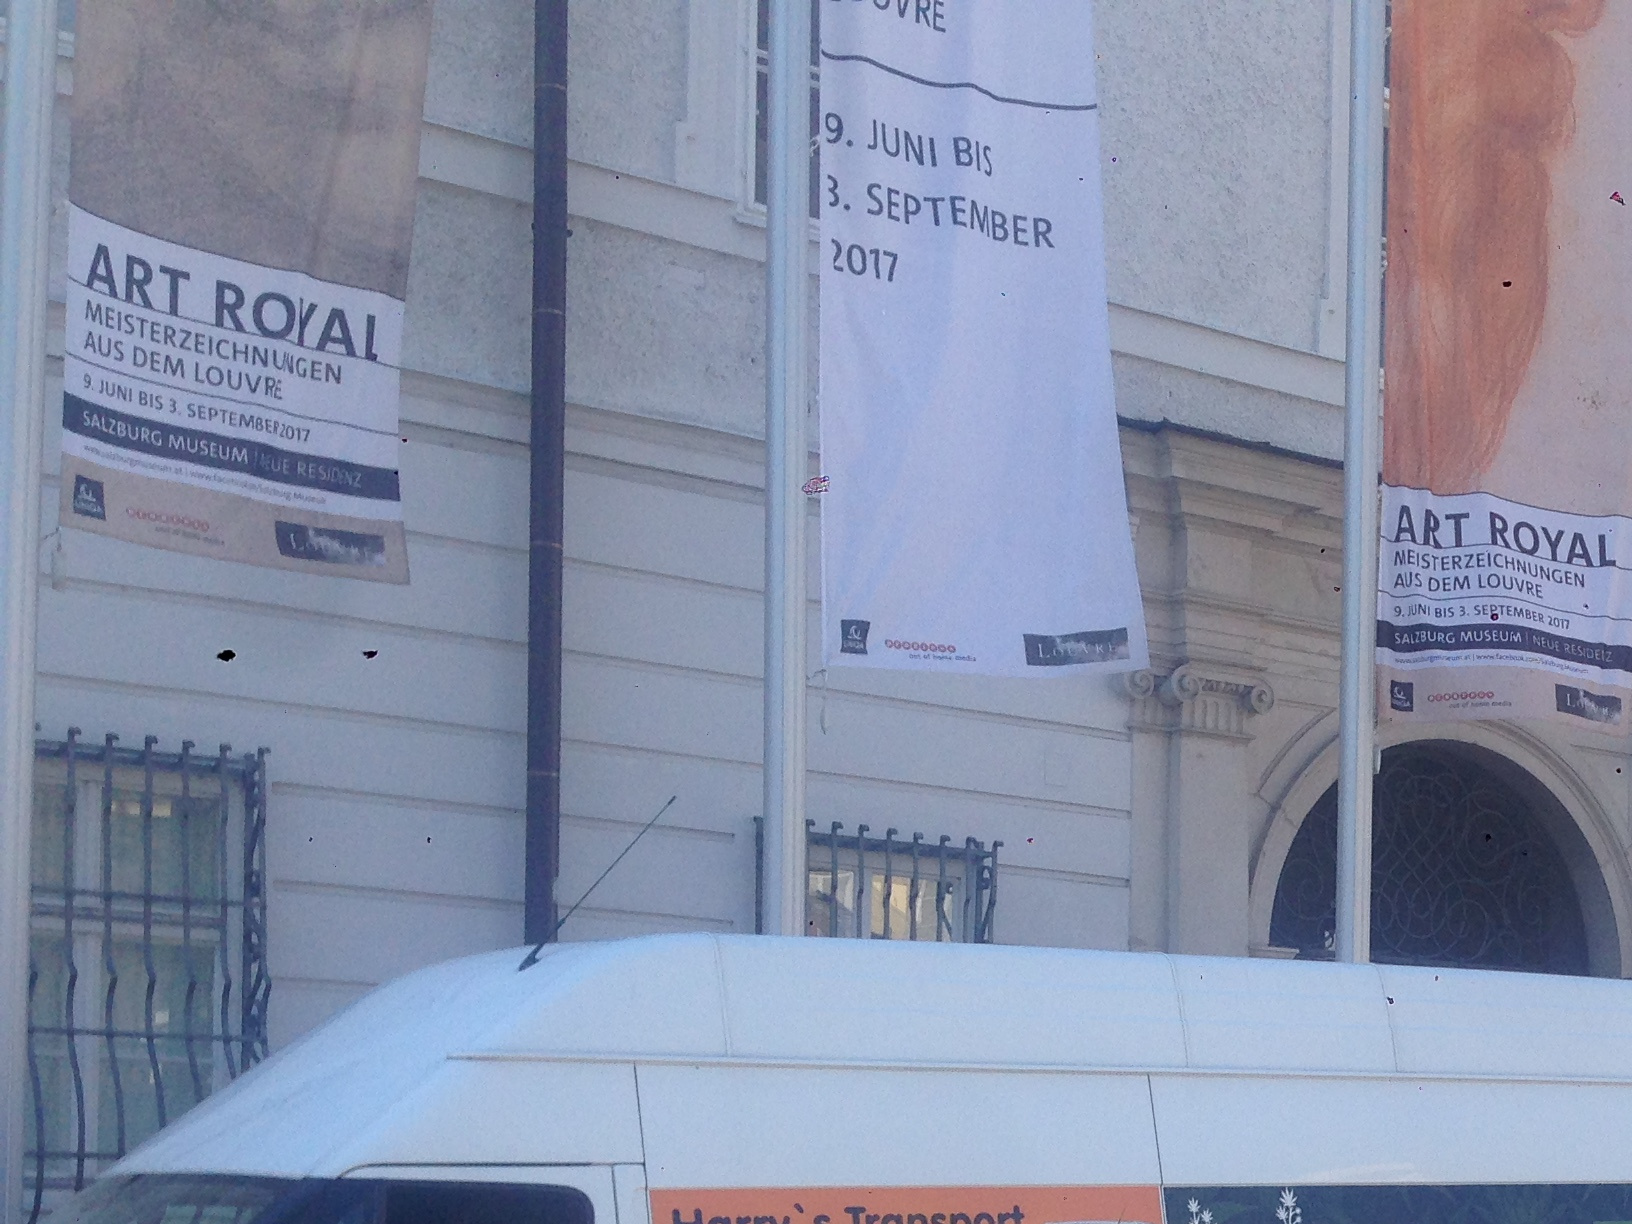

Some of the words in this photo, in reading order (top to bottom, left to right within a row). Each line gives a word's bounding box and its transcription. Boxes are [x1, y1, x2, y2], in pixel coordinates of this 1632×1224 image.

[825, 112, 853, 148] 9.
[867, 119, 937, 167] JUNI
[953, 136, 993, 177] BIS
[827, 175, 851, 211] 3.
[867, 183, 1055, 249] SEPTEMBER
[831, 238, 899, 282] 2017
[86, 243, 190, 316] ART
[215, 279, 378, 361] ROYAL
[84, 331, 124, 361] AUS
[133, 345, 185, 379] DEM
[194, 361, 283, 399] LOUVRE
[83, 373, 96, 392] 9.
[99, 379, 133, 402] JUNI
[139, 389, 163, 410] BIS
[170, 397, 182, 415] 3.
[83, 411, 162, 446] SALZBURG
[169, 435, 248, 464] MUSEUM
[1394, 505, 1470, 549] ART
[1489, 511, 1617, 568] ROYAL
[1394, 549, 1585, 588] MEISTERZEICHNUNGEN
[1394, 571, 1423, 590] AUS
[1428, 573, 1471, 592] DEM
[1478, 572, 1544, 599] LOUVRE
[1394, 606, 1405, 618] 9.
[1407, 603, 1431, 617] JUNI
[1435, 606, 1454, 618] BIS
[1459, 605, 1470, 617] 3.
[1474, 604, 1545, 624] SEPTEMBER
[1548, 614, 1570, 630] 2017
[1394, 631, 1455, 645] SALZBURG
[1460, 629, 1522, 643] MUSEUM
[1532, 634, 1560, 652] NEUE
